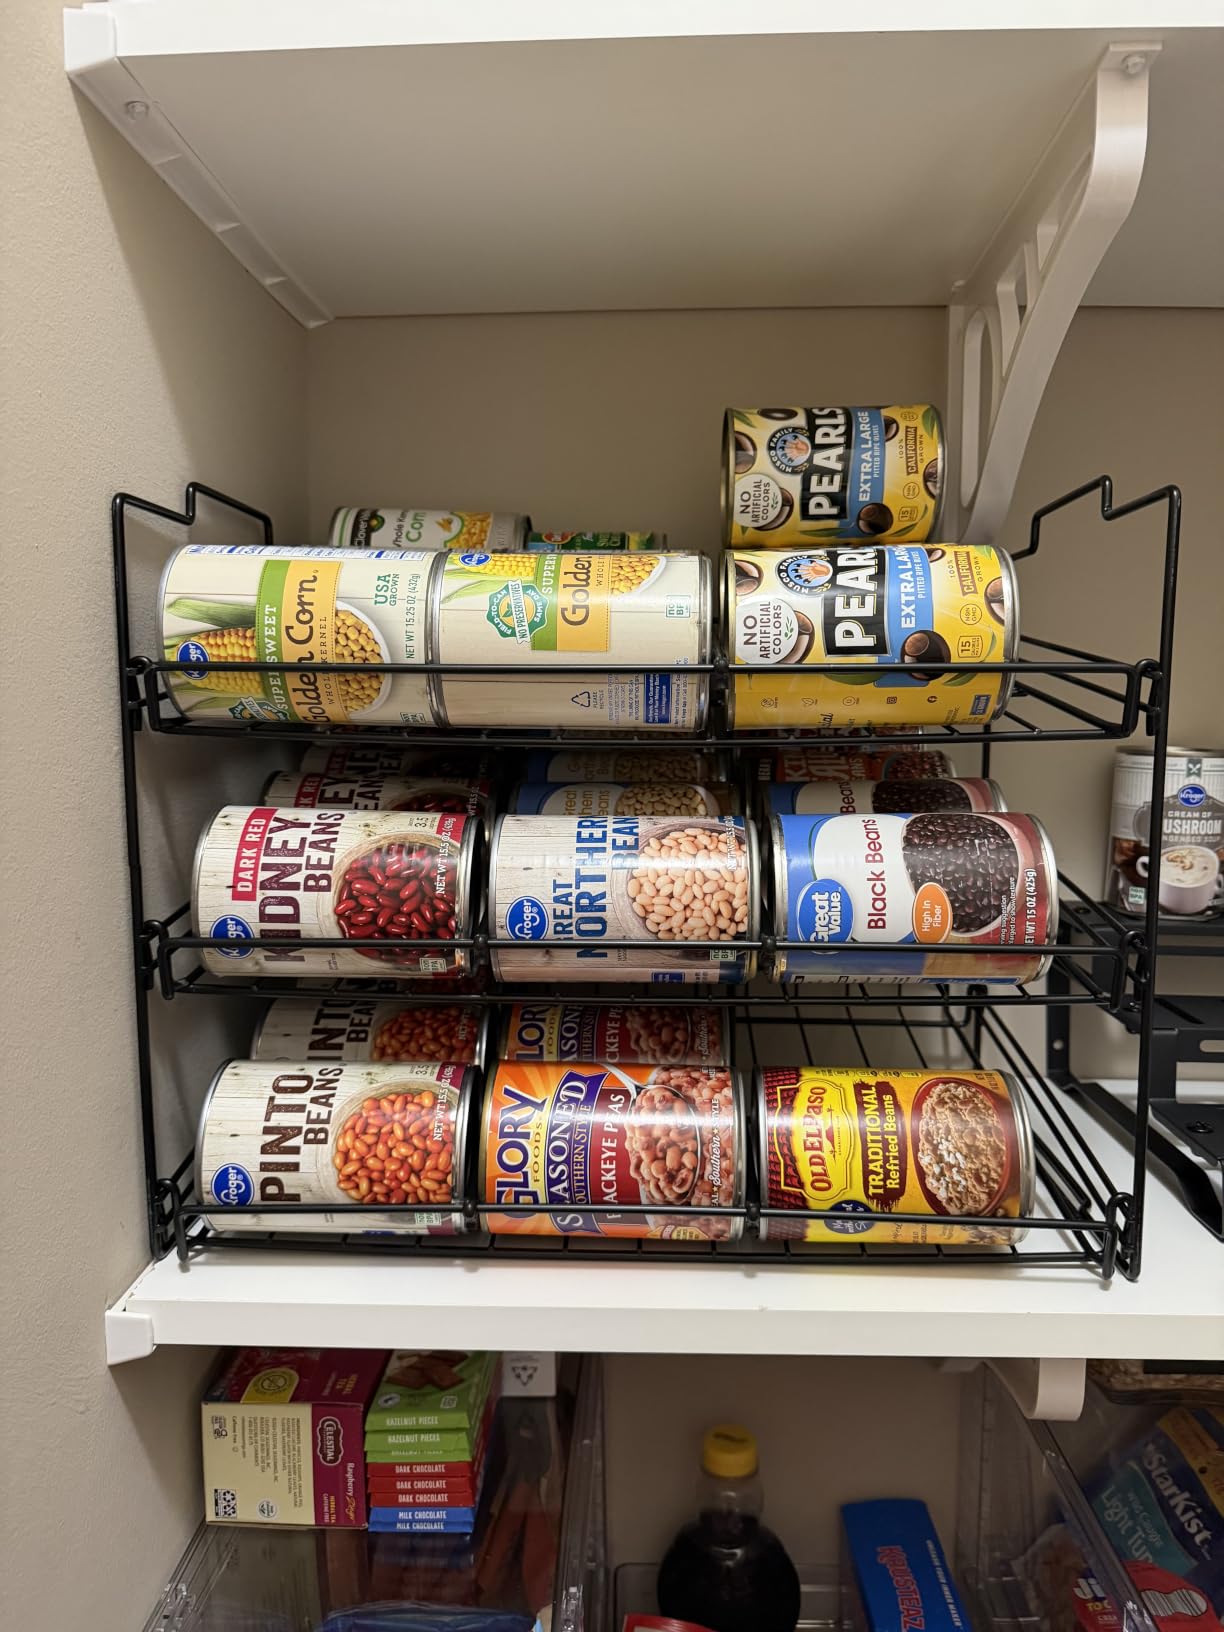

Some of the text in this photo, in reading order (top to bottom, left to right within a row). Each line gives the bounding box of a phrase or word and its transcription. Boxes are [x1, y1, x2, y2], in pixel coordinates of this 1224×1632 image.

[770, 428, 792, 472] MUSCO FAMILY
[808, 407, 846, 516] PEARLS
[858, 411, 872, 501] EXTRA LARGE
[872, 442, 880, 456] RIPE
[872, 458, 880, 478] PITTED
[906, 427, 916, 473] CALIFORNIA
[740, 491, 751, 514] NO
[752, 479, 762, 523] ARTIFICIAL
[762, 482, 770, 520] COLORS
[901, 510, 908, 518] 15
[374, 574, 390, 606] USA
[390, 573, 400, 606] GROWN
[560, 556, 592, 626] Golden
[780, 572, 808, 593] MUSCO
[893, 545, 916, 628] EXTRA LARG
[914, 563, 924, 576] RIPE
[916, 577, 926, 598] PITTED
[285, 575, 318, 645] Corn
[405, 573, 420, 659] NET WT 15.25 OZ (432g)
[491, 590, 512, 634] FIELD-TO-CAN
[510, 583, 527, 639] NO PRESERVATIVES
[526, 588, 543, 622] SAME DAY
[744, 615, 758, 646] NO
[760, 602, 771, 658] ARTIFICIAL
[773, 604, 782, 655] COLORS
[961, 641, 970, 653] 15
[188, 644, 204, 677] Kger
[264, 604, 289, 710] SUPESWEET
[320, 616, 335, 704] WHOL KERNEL
[1168, 810, 1200, 818] CREAM
[1180, 788, 1205, 804] Kroger
[414, 818, 428, 828] 3.5
[612, 818, 639, 869] BEAN
[1164, 820, 1222, 834] USHROOM
[236, 818, 266, 892] DARK RED
[304, 812, 344, 892] BEANS
[436, 832, 450, 894] NET WT 15.5 OZ
[575, 816, 608, 958] NORTHER
[861, 820, 886, 930] Black Beans
[810, 892, 830, 944] Great
[828, 891, 842, 934] Value
[922, 900, 932, 932] High In
[932, 904, 942, 927] Fiber
[1000, 895, 1008, 928] suggestion
[1024, 868, 1037, 944] ET WT 15 OZ (425g)
[220, 919, 245, 958] Kger
[303, 1068, 344, 1144] BEANS
[434, 1104, 445, 1120] WT
[436, 1088, 448, 1103] 15.5
[260, 1074, 314, 1202] PINTO
[432, 1121, 444, 1141] NET
[496, 1087, 548, 1218] GLORY
[533, 1122, 542, 1182] FOODS
[862, 1086, 884, 1196] TRADITIONAL
[882, 1094, 900, 1188] Refried Beans
[548, 1081, 586, 1226] SASONED
[574, 1145, 586, 1204] OUTHERN
[709, 1136, 720, 1186] Southern
[803, 1128, 833, 1192] OLD EL
[324, 1420, 337, 1462] CELESTIAL
[386, 1416, 438, 1426] HAZELNUT PIECES
[388, 1434, 418, 1444] HAZELNUT
[345, 1462, 355, 1497] Raspberry
[396, 1464, 445, 1473] DARK CHOCOLATE
[396, 1480, 446, 1489] DARK CHOCOLATE
[398, 1494, 448, 1502] DARK CHOCOLATE
[414, 1511, 447, 1519] CHOCOLATE
[1101, 1485, 1130, 1535] Light
[1144, 1450, 1213, 1546] StarKist
[396, 1522, 444, 1530] MILK CHOCOLATE
[876, 1545, 926, 1632] KRUSTEAZ
